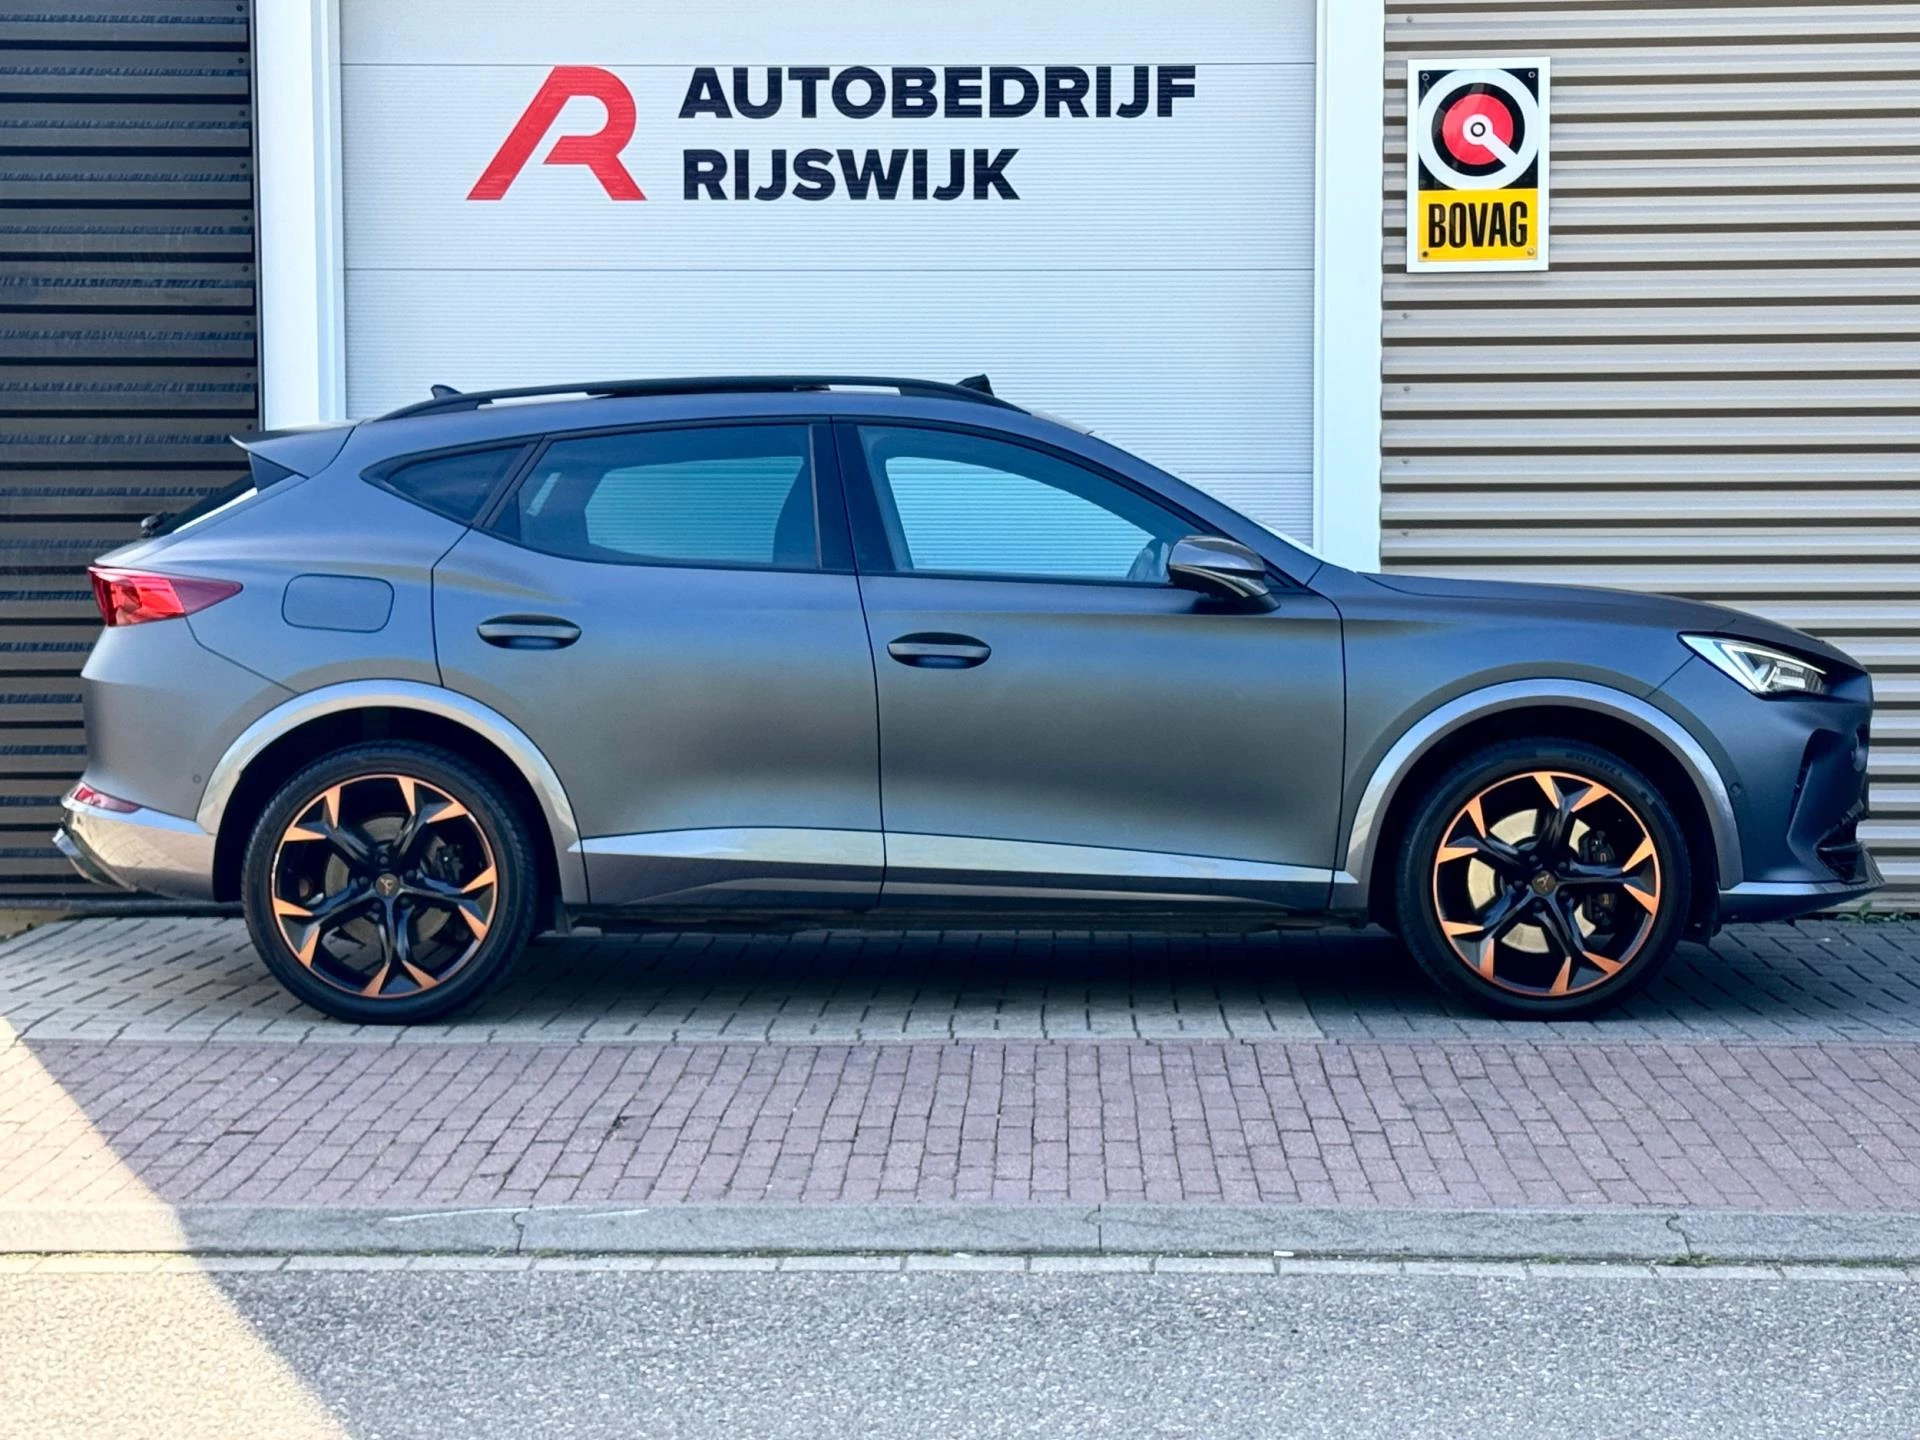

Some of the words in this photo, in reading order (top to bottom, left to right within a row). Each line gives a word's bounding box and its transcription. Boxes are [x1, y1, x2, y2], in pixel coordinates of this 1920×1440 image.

[678, 66, 1196, 119] AUTOBEDRIJF
[683, 148, 1020, 200] RIJSWIJK
[1428, 201, 1528, 248] BOVAG
